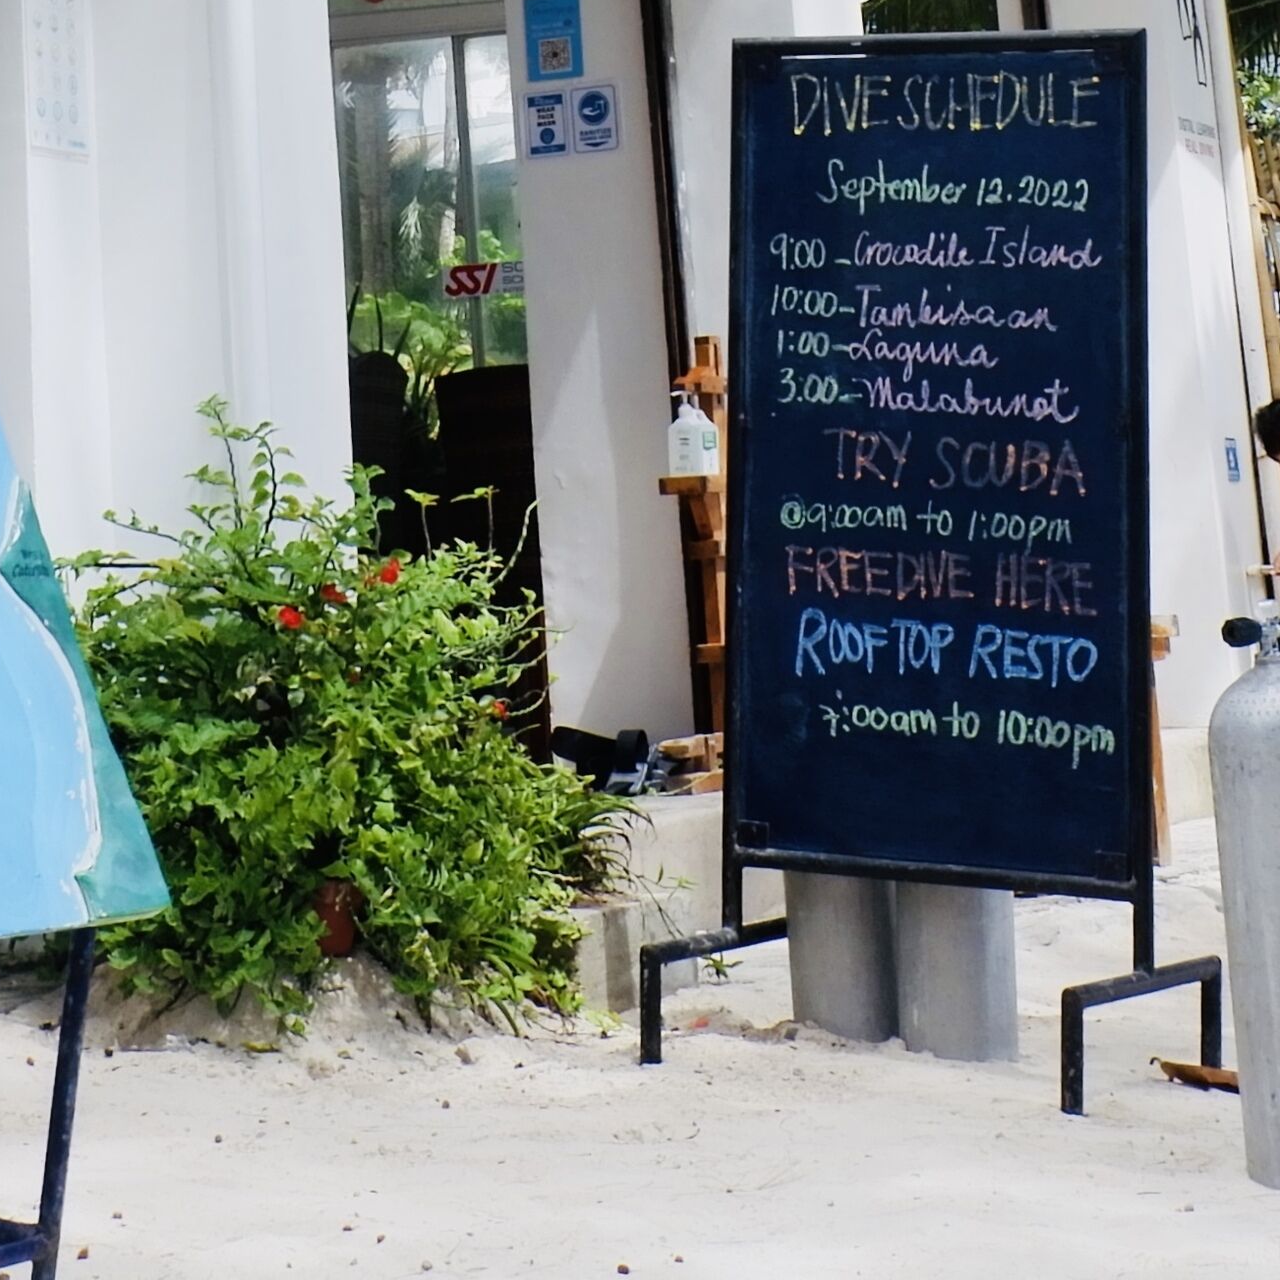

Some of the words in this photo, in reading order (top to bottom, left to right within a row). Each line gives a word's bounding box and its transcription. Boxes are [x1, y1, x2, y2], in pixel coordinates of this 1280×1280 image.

[790, 73, 892, 136] DIVE
[896, 70, 1100, 132] SCHEDULE
[816, 158, 966, 215] September
[445, 263, 497, 296] SSI
[978, 225, 1102, 270] Island
[824, 428, 913, 488] TRY
[929, 437, 1087, 497] SCUBA
[916, 501, 952, 536] to
[995, 552, 1098, 616] HERE
[968, 624, 1099, 688] RESTO
[941, 701, 979, 739] to
[998, 710, 1116, 770] 10:00pm
